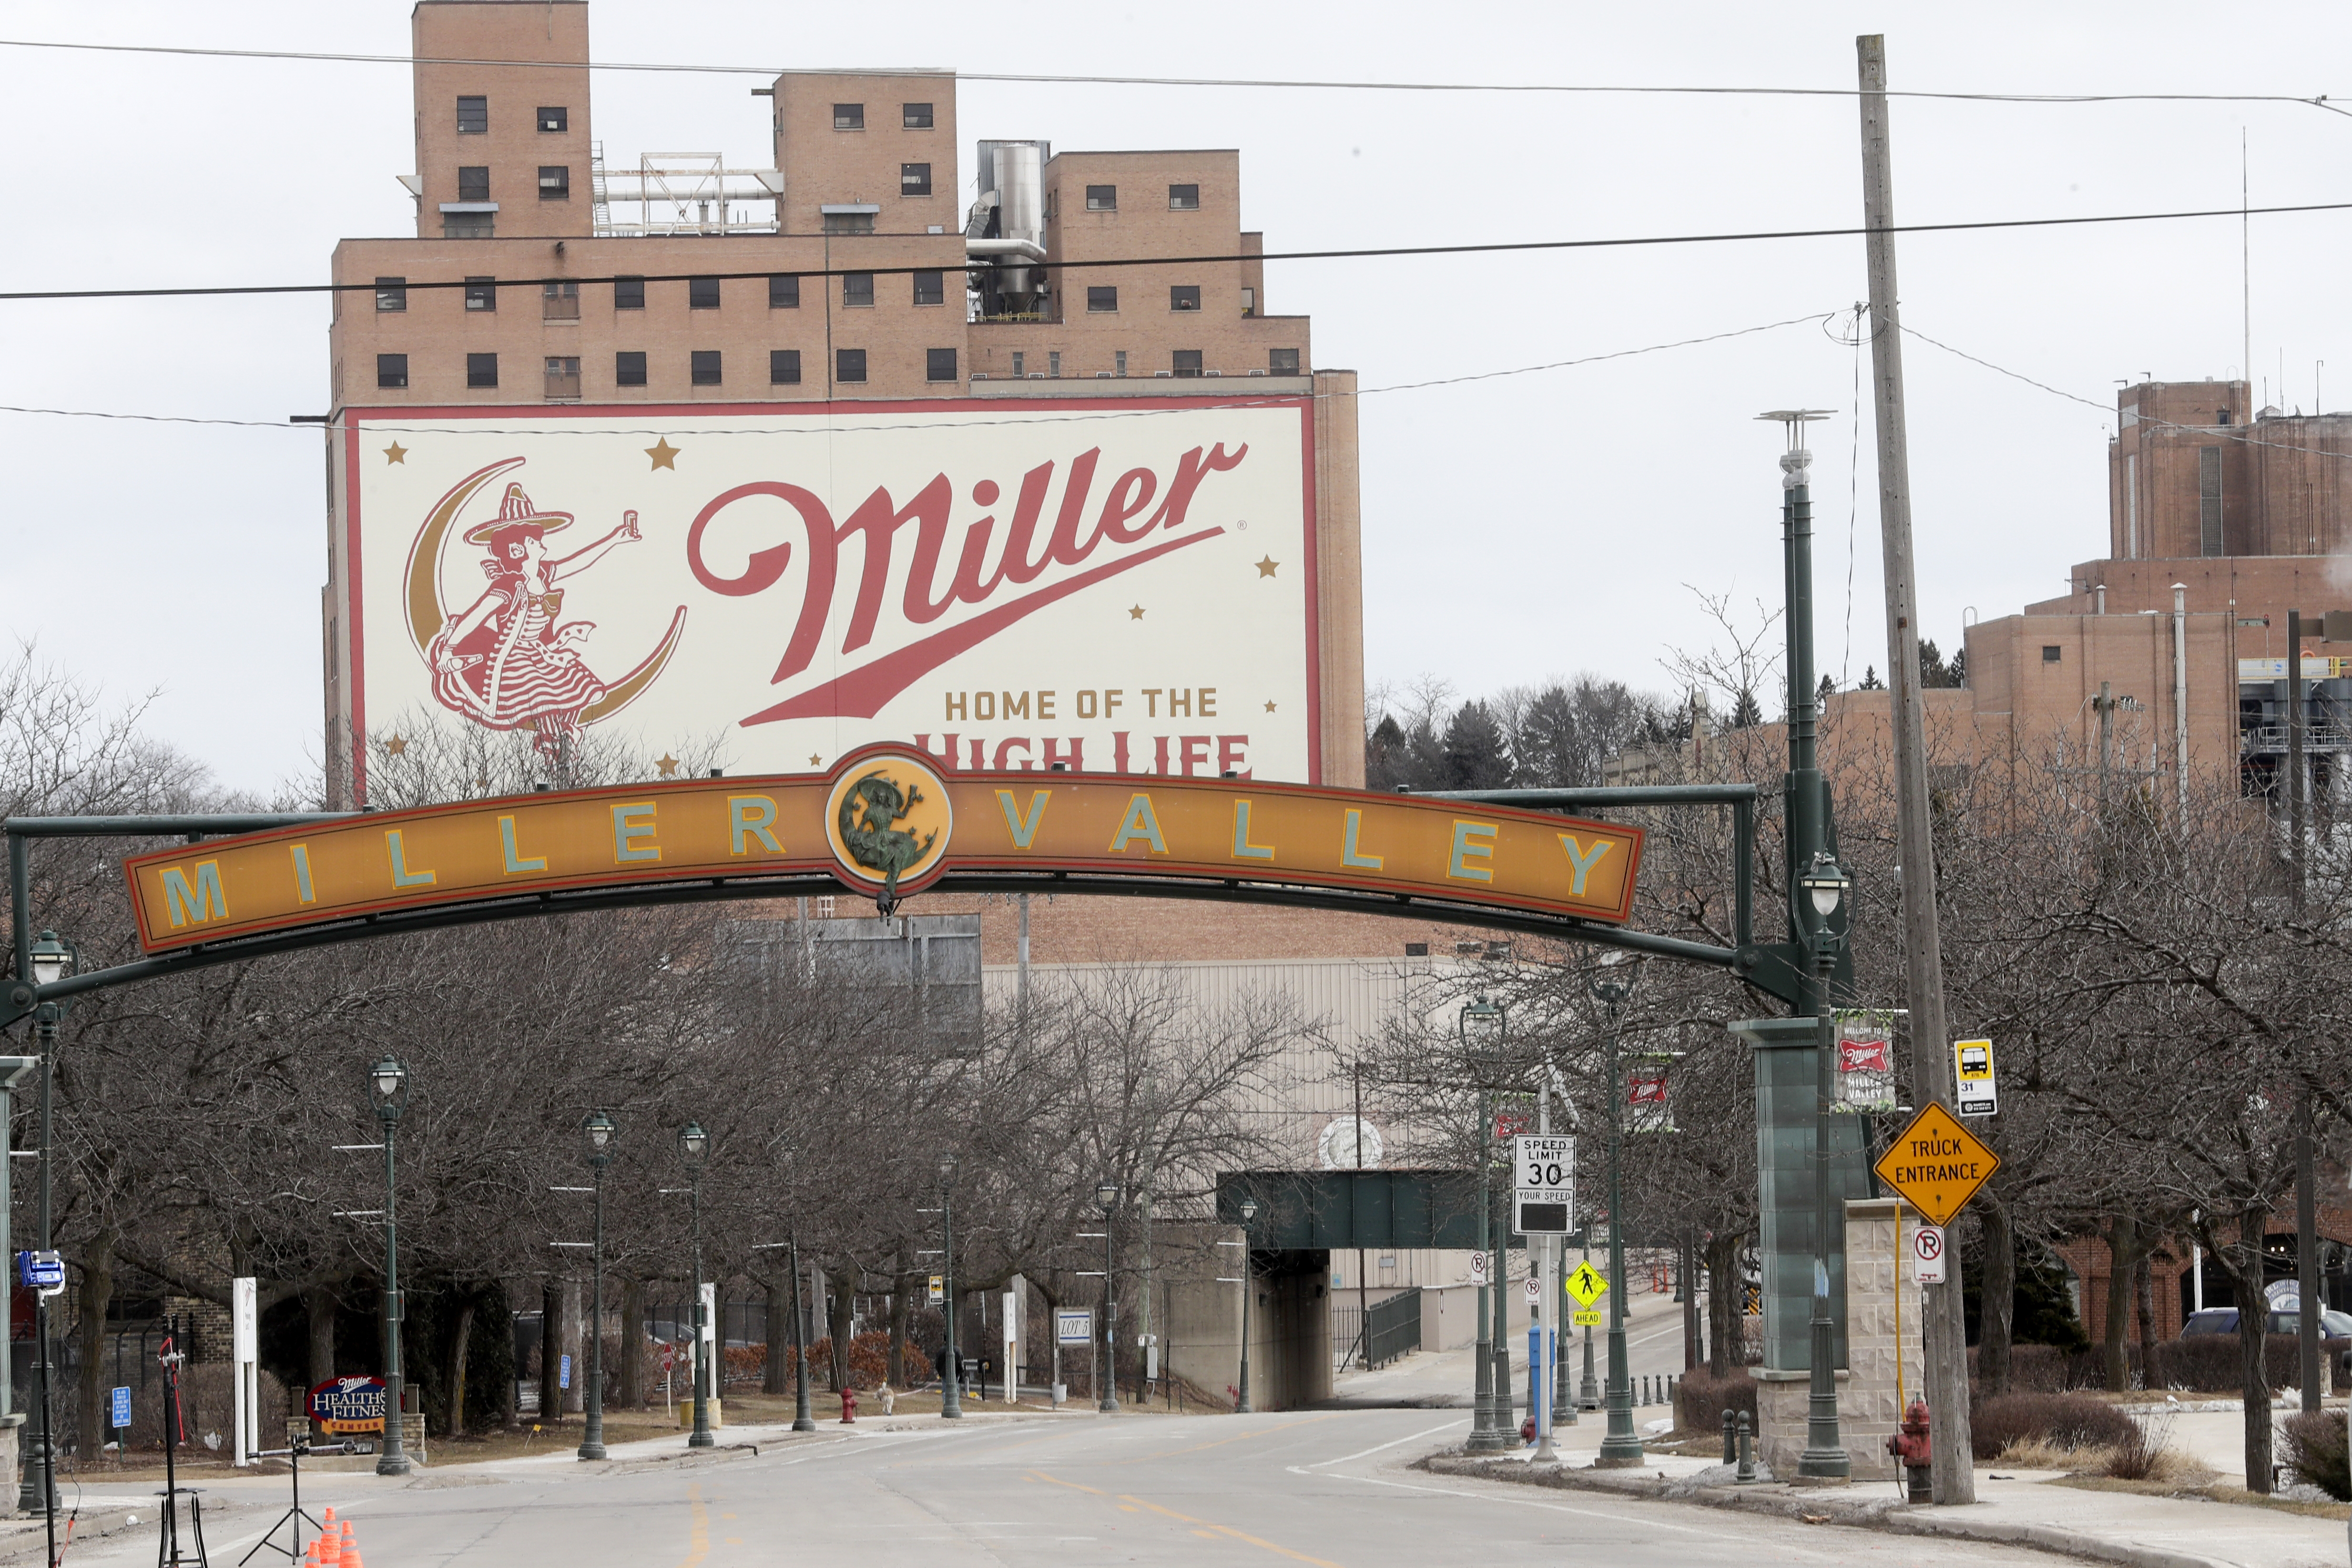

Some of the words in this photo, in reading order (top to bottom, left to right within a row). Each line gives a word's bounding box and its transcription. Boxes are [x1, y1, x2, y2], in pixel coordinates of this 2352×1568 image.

[687, 442, 1249, 727] Miller
[946, 691, 1056, 721] HOME
[1077, 690, 1123, 719] OF
[1141, 688, 1217, 718] THE
[159, 794, 786, 929] MILLER
[995, 789, 1615, 898] VALLEY
[1846, 1048, 1880, 1065] Miller
[1848, 1089, 1882, 1099] VALLEY
[1961, 1082, 1973, 1092] 31
[1524, 1140, 1567, 1150] SPEED
[1910, 1139, 1963, 1157] TRUCK
[1528, 1151, 1562, 1161] LIMIT
[1528, 1163, 1562, 1185] 30
[1895, 1163, 1980, 1183] ENTRANCE
[1519, 1191, 1540, 1200] YOUR
[1545, 1192, 1570, 1200] SPEED
[1576, 1313, 1599, 1323] AHEAD
[1060, 1320, 1081, 1334] LOT
[1082, 1320, 1089, 1334] 5
[338, 1376, 372, 1394] Miller
[313, 1392, 380, 1411] HEALTH
[332, 1405, 386, 1422] FITNES
[331, 1421, 379, 1430] CENTER
